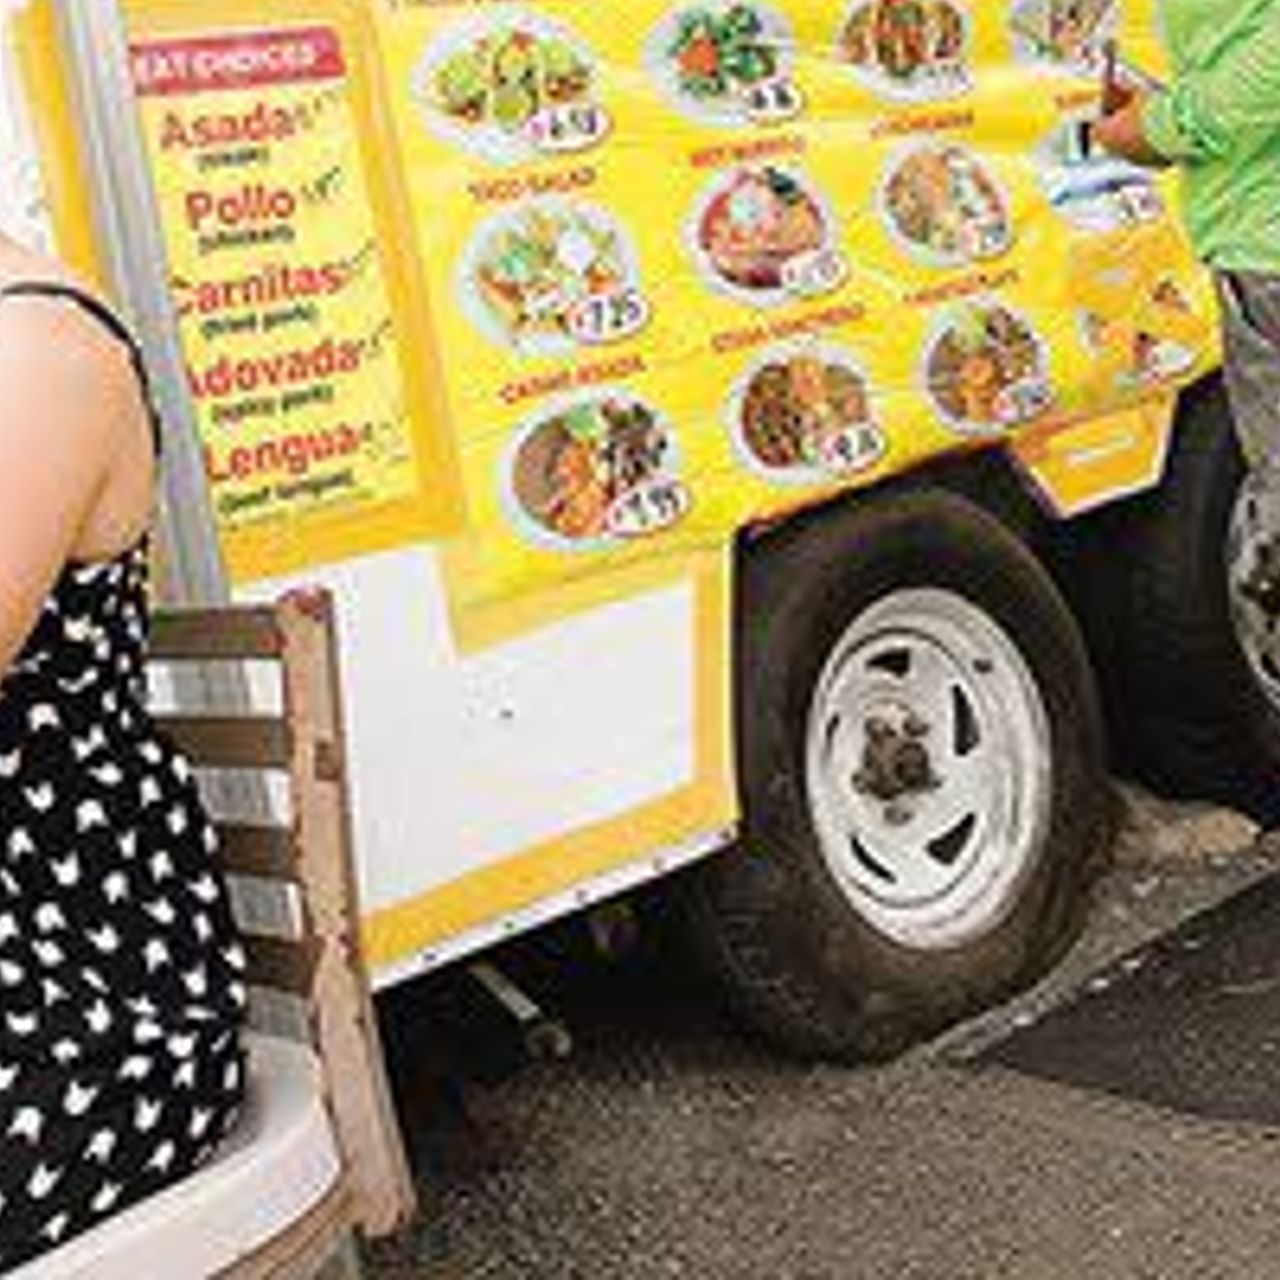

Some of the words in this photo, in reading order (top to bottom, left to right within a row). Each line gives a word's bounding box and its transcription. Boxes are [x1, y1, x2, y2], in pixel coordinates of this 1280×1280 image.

[160, 102, 297, 151] Asada
[185, 183, 296, 231] Pollo
[204, 423, 360, 484] Lengua
